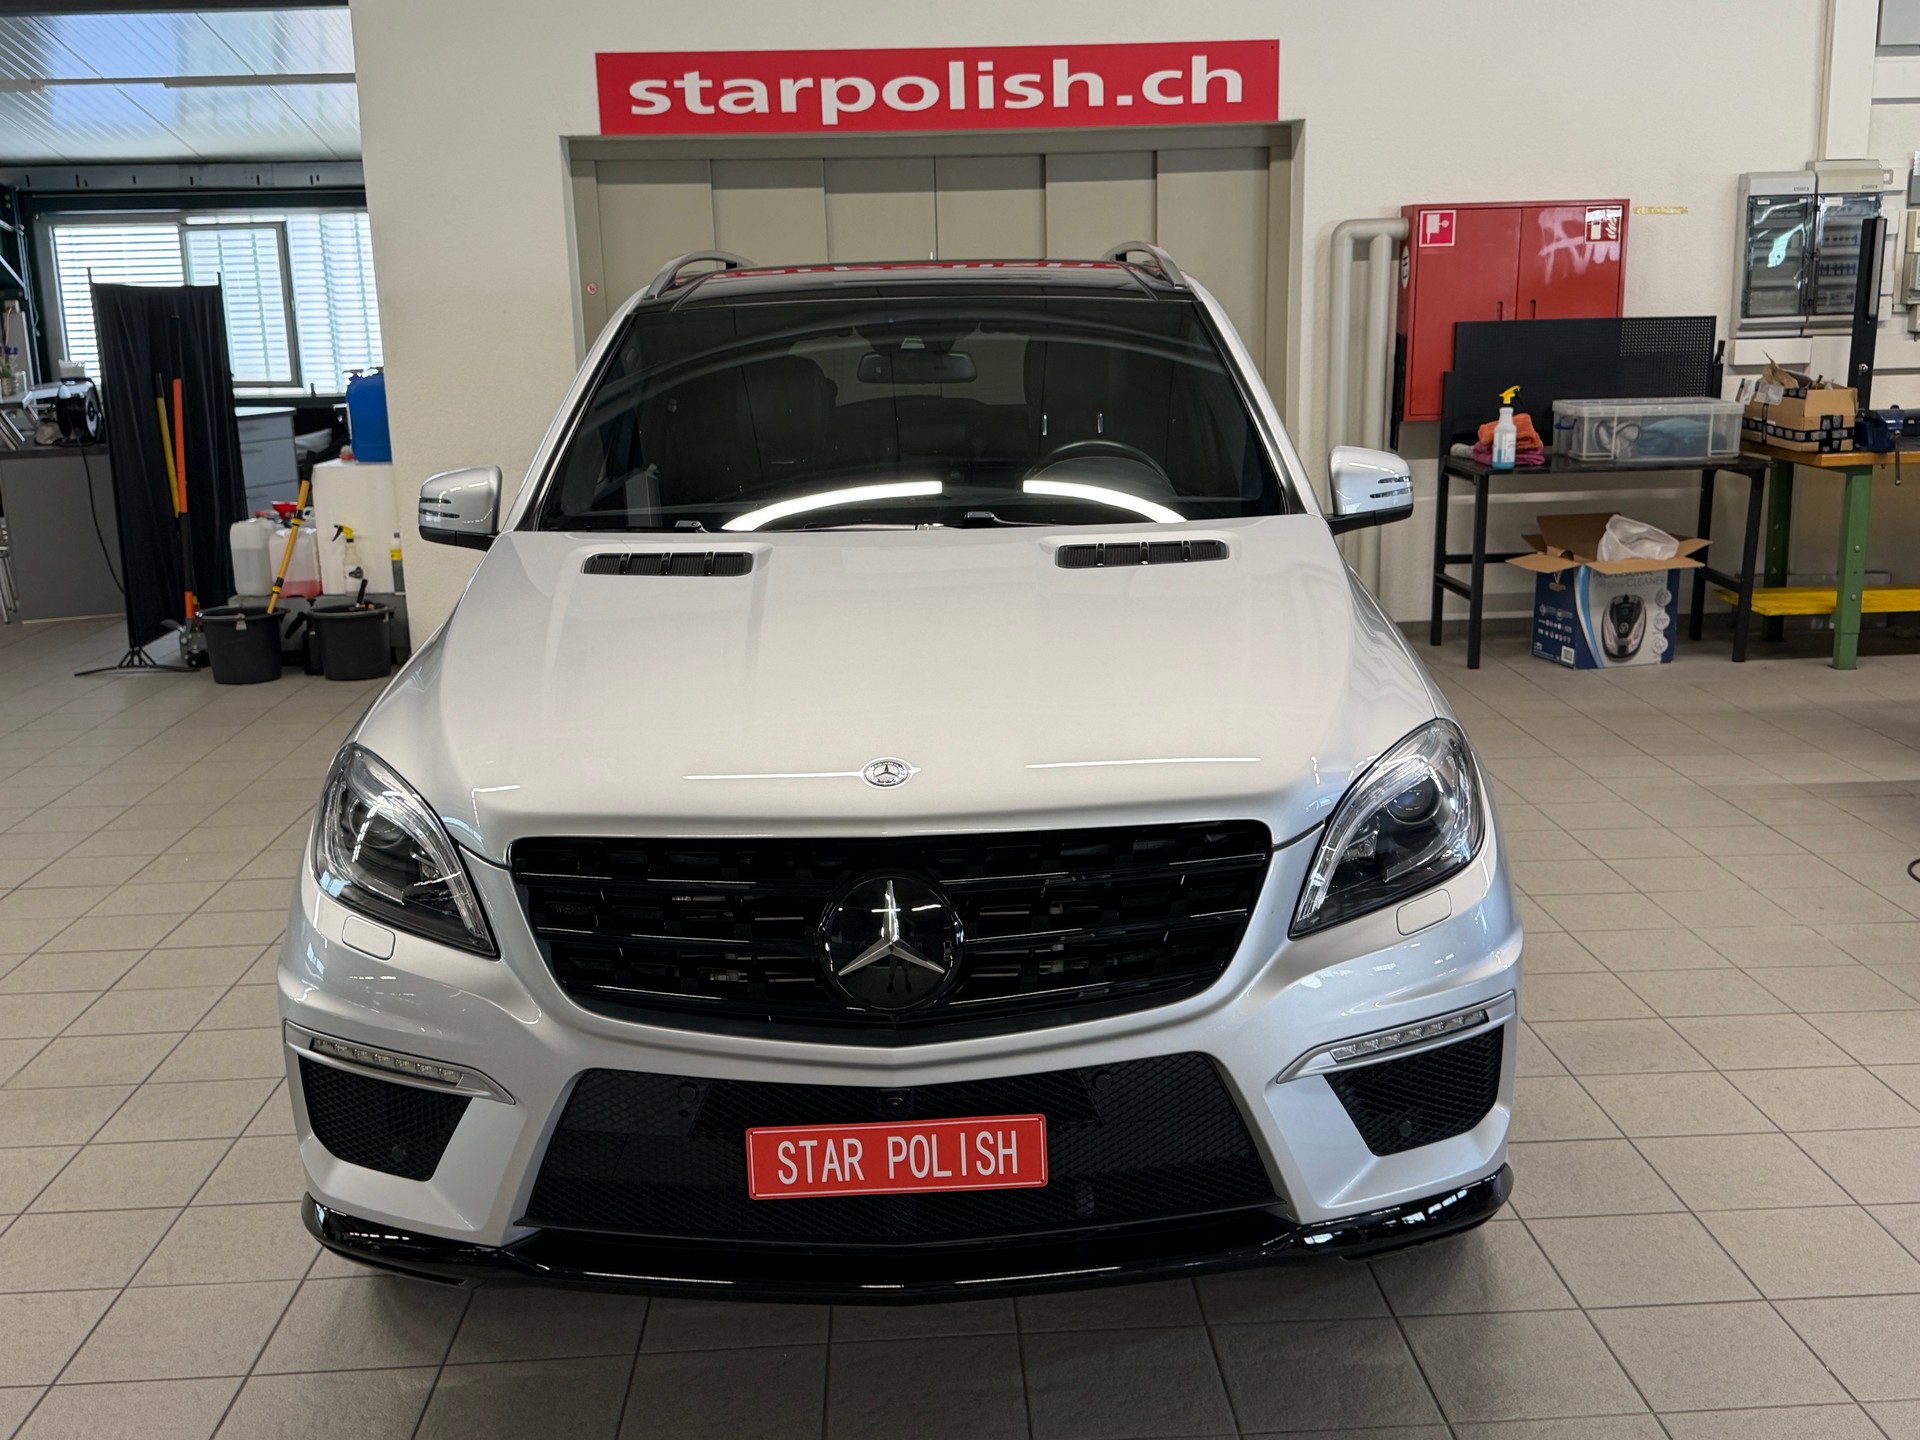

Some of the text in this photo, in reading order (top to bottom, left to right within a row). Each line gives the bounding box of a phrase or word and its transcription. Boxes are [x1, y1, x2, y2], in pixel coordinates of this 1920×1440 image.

[629, 55, 1243, 125] starpolish.ch
[1626, 576, 1666, 588] CLEANER
[777, 1130, 1018, 1185] STAR POLISH
